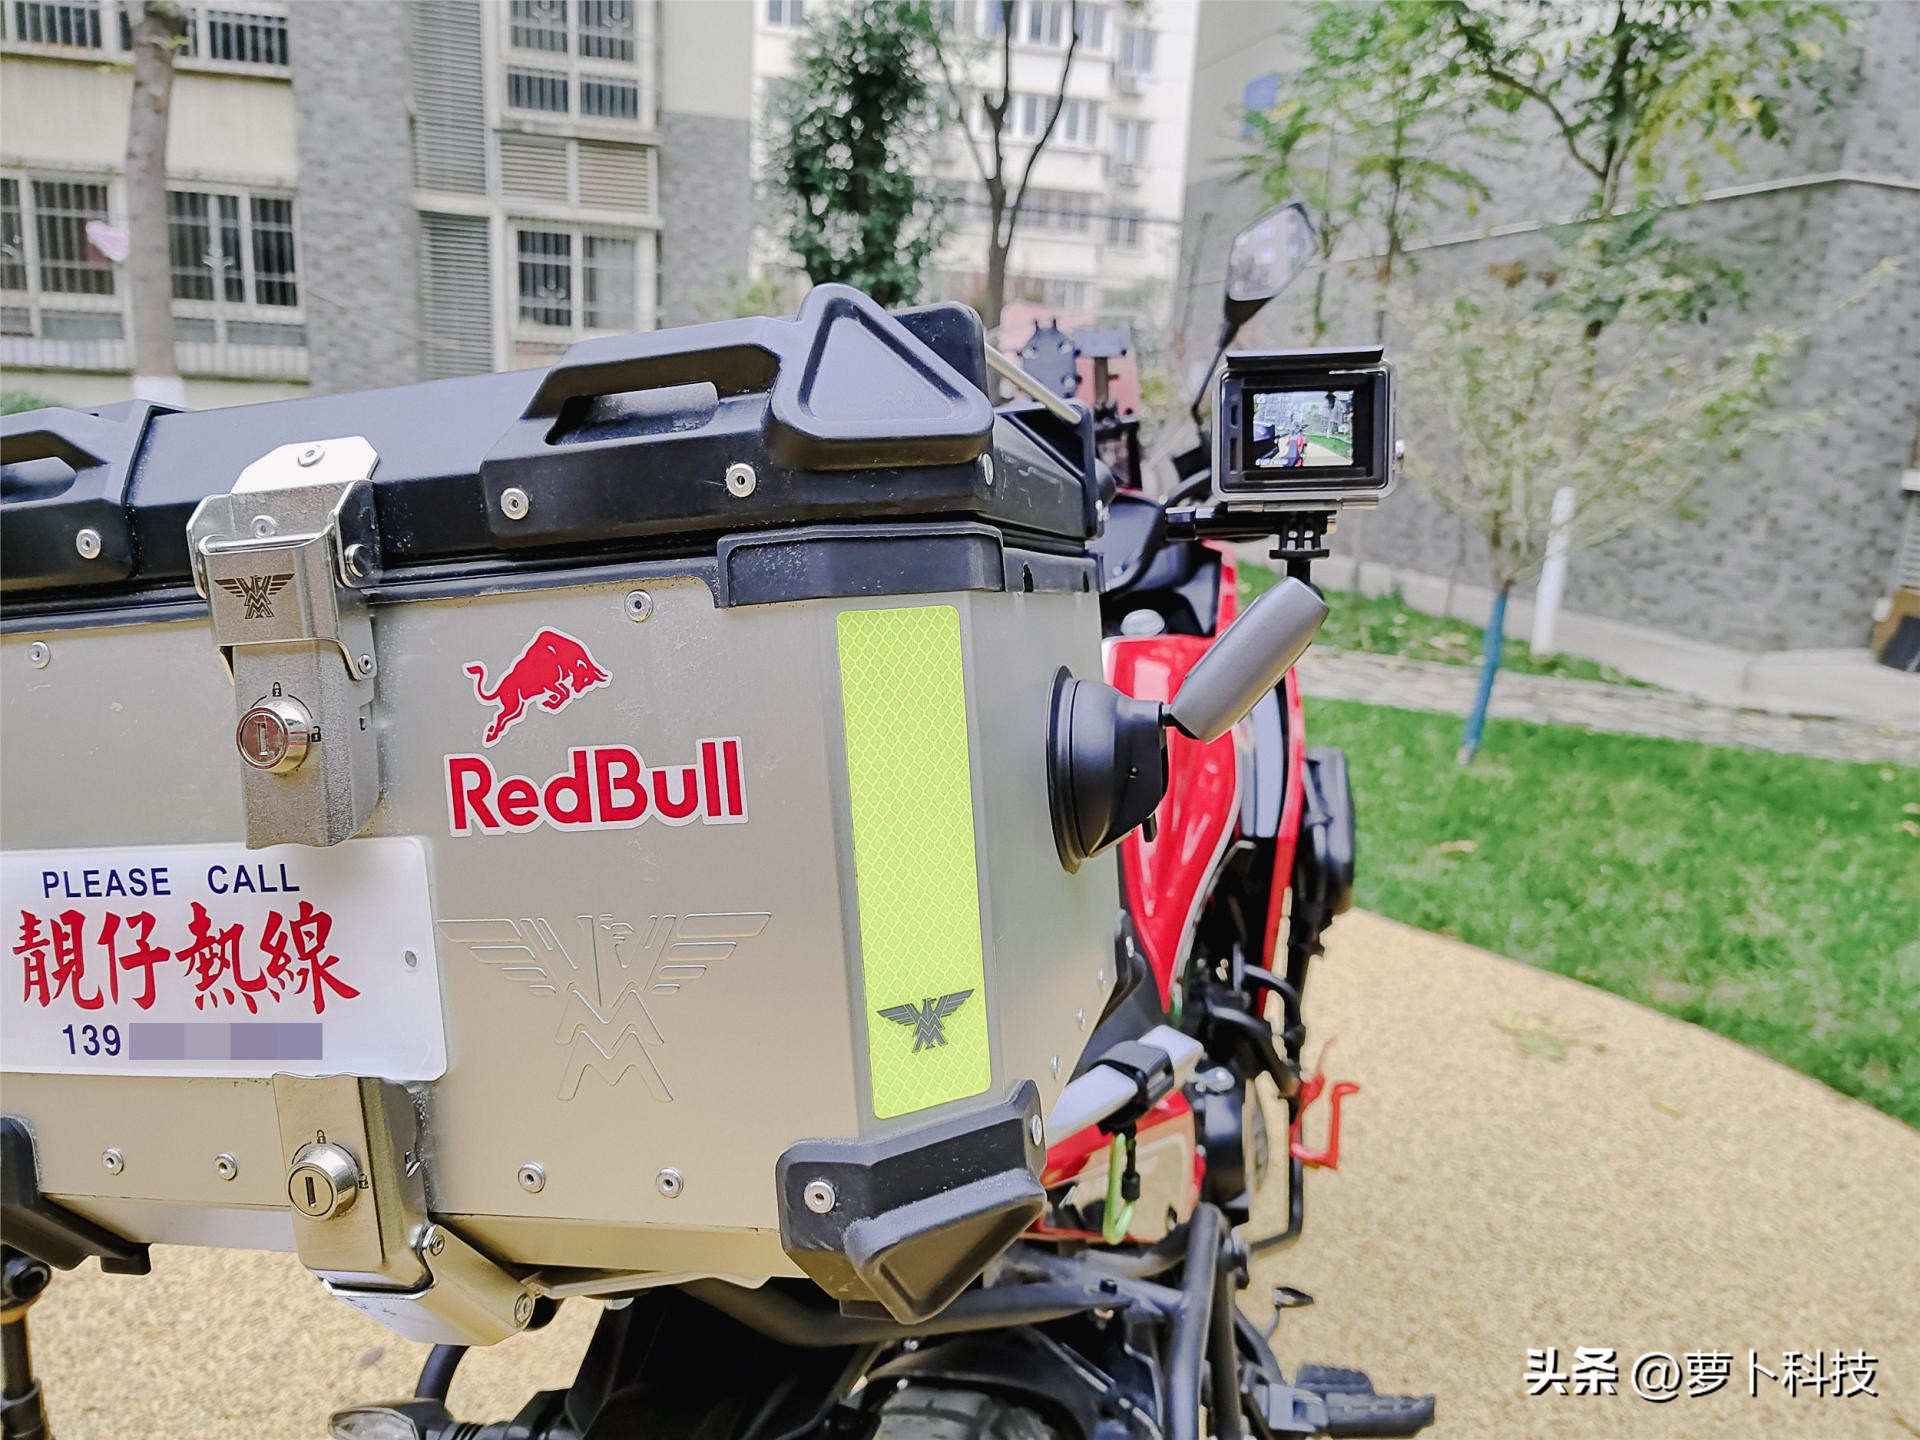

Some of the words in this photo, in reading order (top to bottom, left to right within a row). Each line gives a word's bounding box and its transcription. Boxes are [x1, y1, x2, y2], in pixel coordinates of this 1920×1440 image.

[449, 740, 742, 830] RedBull
[42, 868, 172, 899] PLEASE
[207, 863, 300, 895] CALL
[12, 901, 361, 1015] 靚仔熱線
